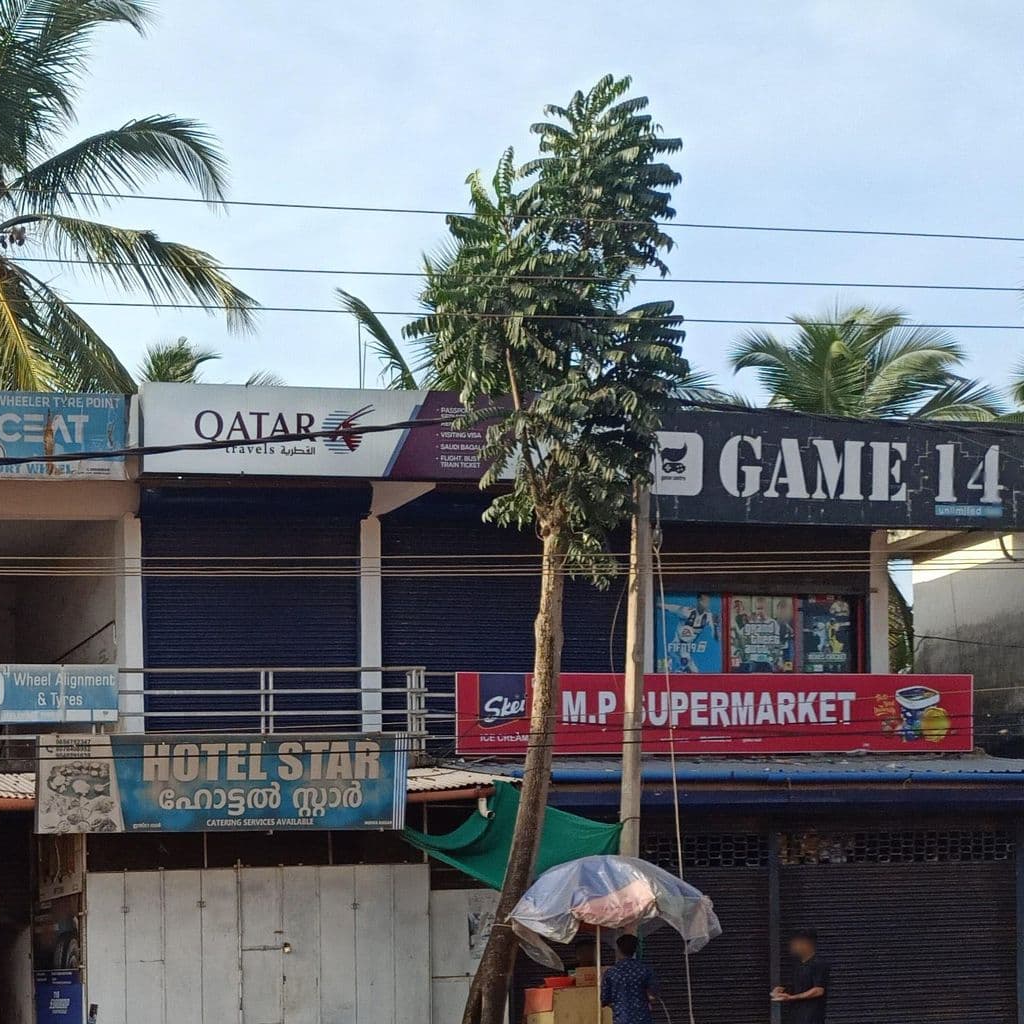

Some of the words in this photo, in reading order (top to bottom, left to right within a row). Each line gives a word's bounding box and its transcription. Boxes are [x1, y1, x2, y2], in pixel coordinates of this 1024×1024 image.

[54, 396, 83, 409] TYRE
[85, 397, 120, 409] POINT
[194, 409, 316, 443] QATAR
[719, 434, 907, 502] GAME
[934, 443, 1004, 503] 14
[13, 672, 51, 687] Wheel
[55, 673, 115, 689] Alignment
[37, 693, 47, 706] &
[50, 692, 83, 708] Tyres
[561, 690, 617, 726] M.P
[641, 691, 856, 728] UPERMARKET
[142, 742, 268, 782] HOTEL
[277, 741, 381, 781] STAR
[158, 781, 281, 817] ഹോട്ടൽ
[206, 818, 242, 828] CATERING
[243, 818, 275, 827] SERVICES
[276, 817, 314, 827] AVAILABLE
